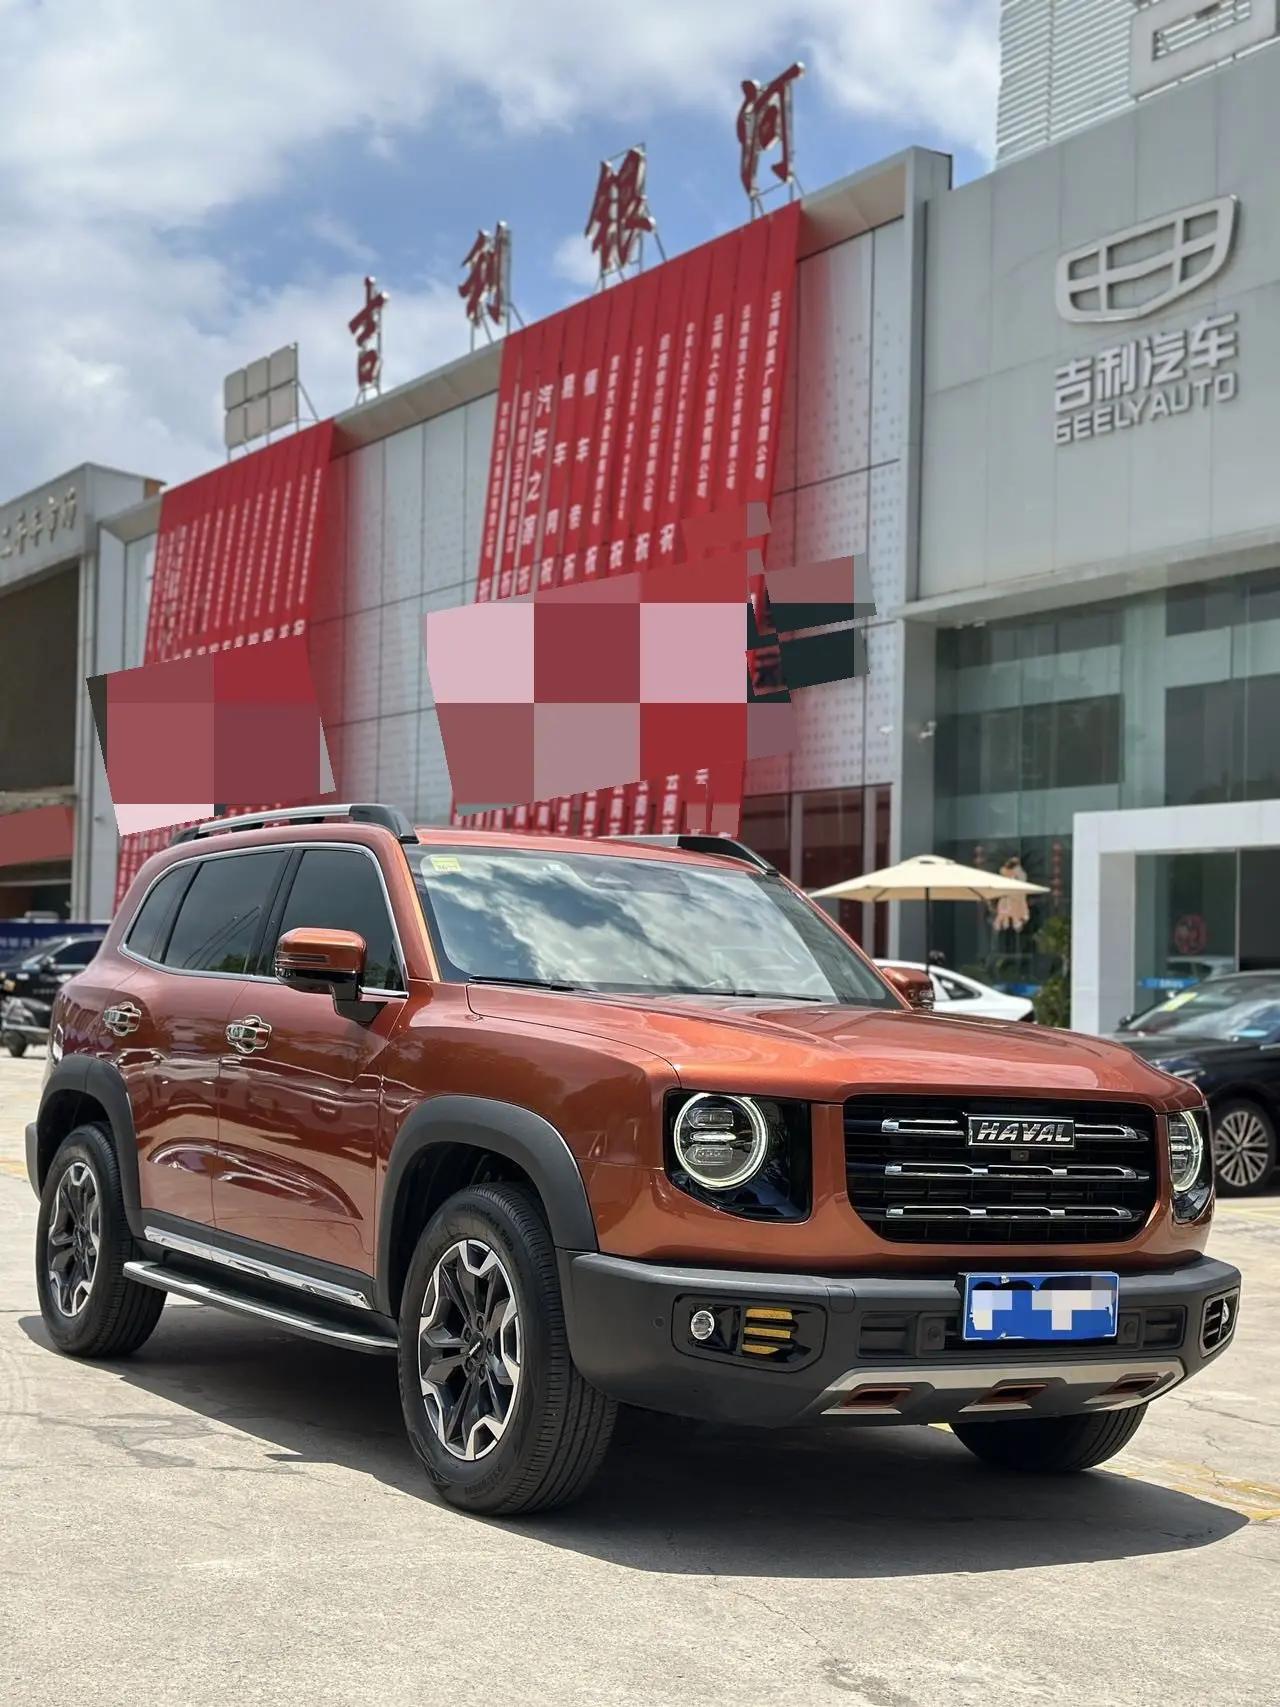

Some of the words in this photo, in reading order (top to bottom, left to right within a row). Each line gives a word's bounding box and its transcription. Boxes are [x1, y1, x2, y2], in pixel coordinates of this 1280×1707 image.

[1054, 313, 1239, 414] 吉利汽车
[977, 1122, 1071, 1142] HAVAL
